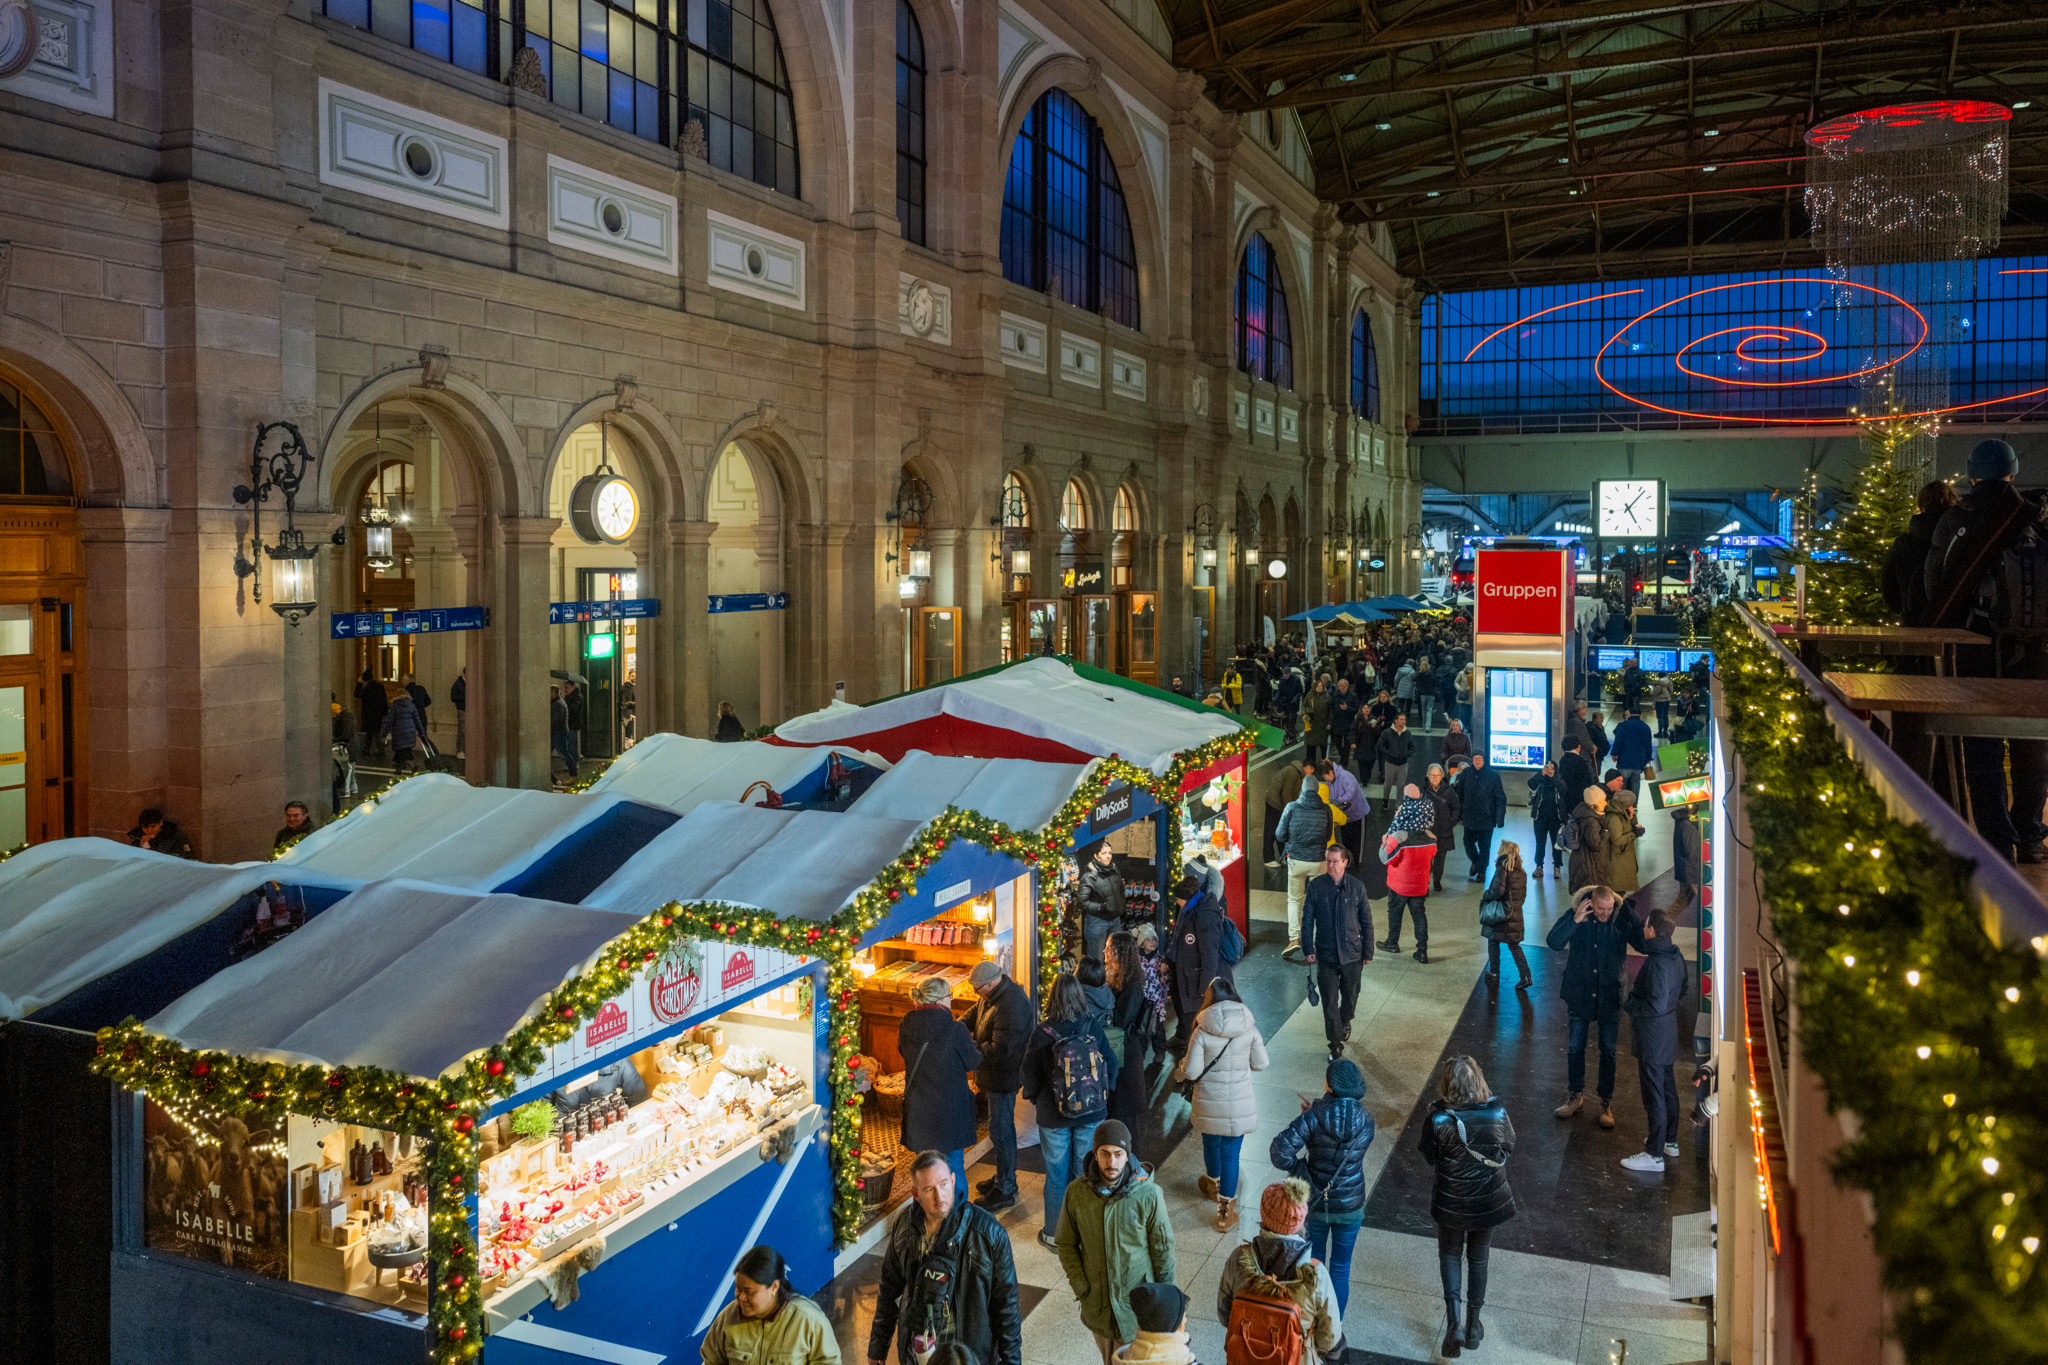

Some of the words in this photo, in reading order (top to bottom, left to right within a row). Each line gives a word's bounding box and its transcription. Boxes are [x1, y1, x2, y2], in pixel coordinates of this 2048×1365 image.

[1962, 318, 1970, 327] 8
[1483, 582, 1557, 600] Gruppen
[1096, 797, 1128, 821] DillySocks
[724, 963, 753, 981] ISABELLE
[660, 976, 697, 1014] CHRISTMAS
[590, 1015, 626, 1037] ISABELLE
[176, 1209, 253, 1242] ISABELLE
[176, 1230, 195, 1241] CARE
[206, 1237, 253, 1255] FRAGRANCE
[925, 1269, 946, 1282] N7
